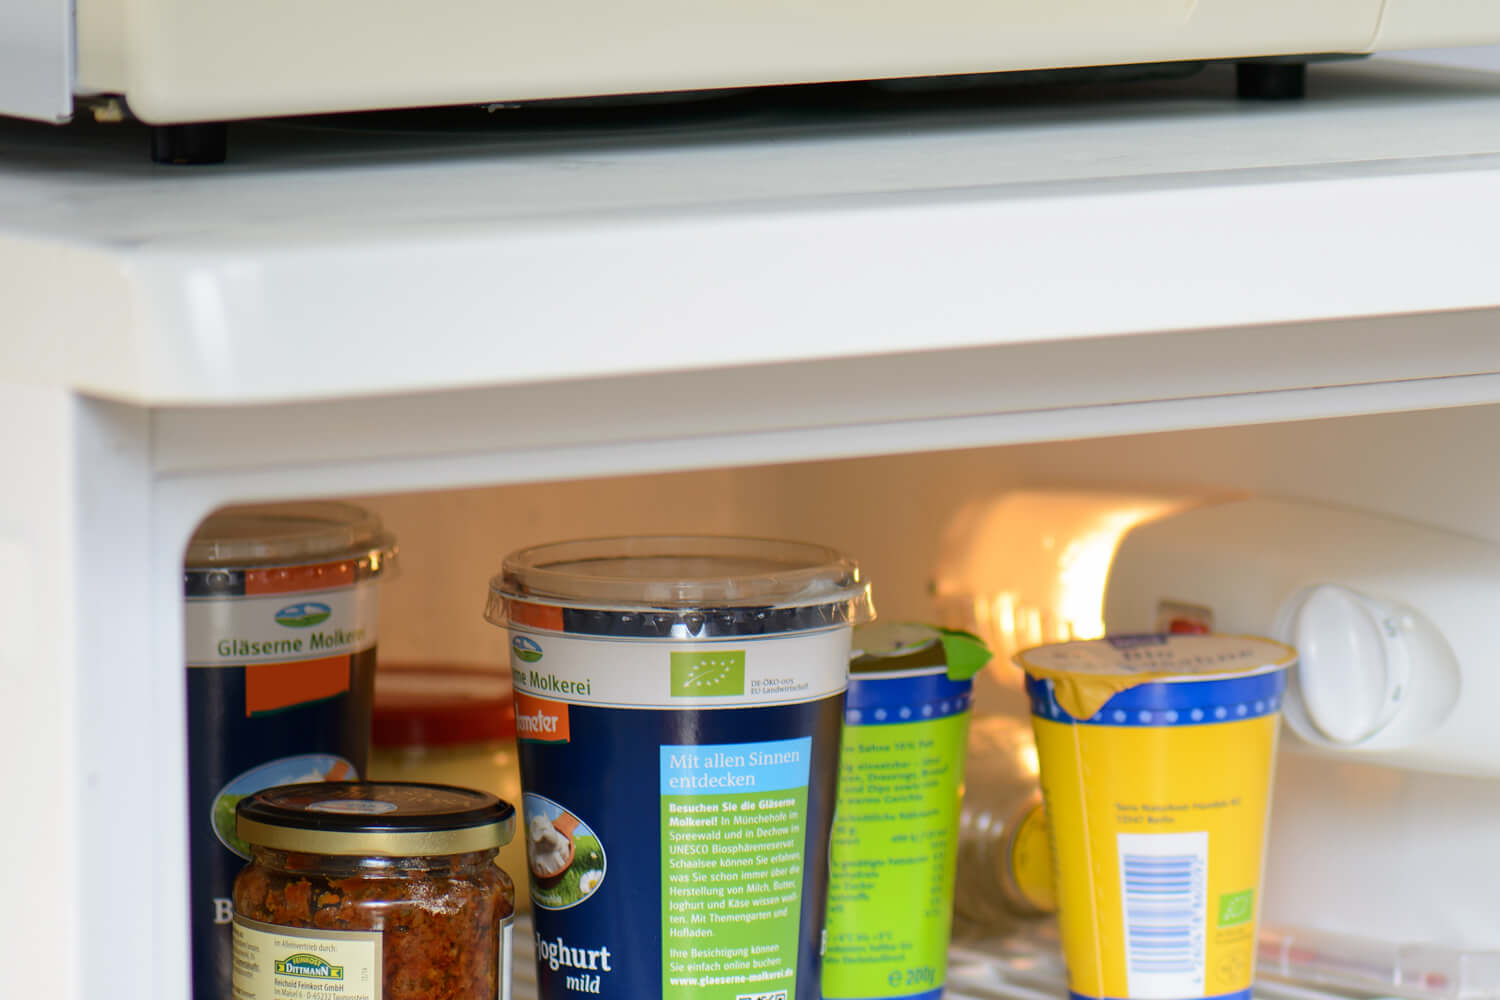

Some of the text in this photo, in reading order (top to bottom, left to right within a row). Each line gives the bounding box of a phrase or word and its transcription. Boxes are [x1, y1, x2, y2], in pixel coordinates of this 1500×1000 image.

[217, 638, 304, 657] Gläserne
[529, 670, 592, 696] Molkerei
[669, 750, 801, 769] Mit allen Sinnen
[669, 771, 756, 789] entdecken
[669, 798, 796, 813] Besuchen Sie die Gläserne
[669, 817, 718, 827] Molkerei!
[721, 816, 730, 826] In
[733, 811, 787, 825] Münchehofe
[669, 831, 721, 842] Spreewald
[724, 829, 742, 839] und
[745, 829, 754, 839] in
[669, 839, 795, 855] UNESCO Biosphärenreservat
[669, 858, 717, 869] Schaalsee
[720, 856, 753, 867] können
[756, 855, 768, 865] Sie
[669, 874, 689, 883] was
[692, 871, 707, 882] Sie
[710, 870, 739, 881] schon
[741, 869, 768, 879] immer
[669, 886, 725, 898] Herstellung
[727, 886, 744, 895] von
[669, 899, 705, 911] Joghurt
[707, 898, 726, 909] und
[728, 896, 749, 907] Käse
[752, 895, 780, 906] wissen
[669, 907, 788, 924] ten. Mit Themengarten und
[669, 943, 780, 959] Ihre Besichtigung können
[286, 963, 329, 977] DITTMANN
[669, 961, 684, 972] Sie
[687, 960, 721, 972] einfach
[723, 959, 750, 970] online
[566, 974, 601, 994] mild
[669, 967, 794, 988] www.glaeserne-molkerei.de
[298, 981, 324, 991] Feinkost
[324, 982, 344, 993] GmbH
